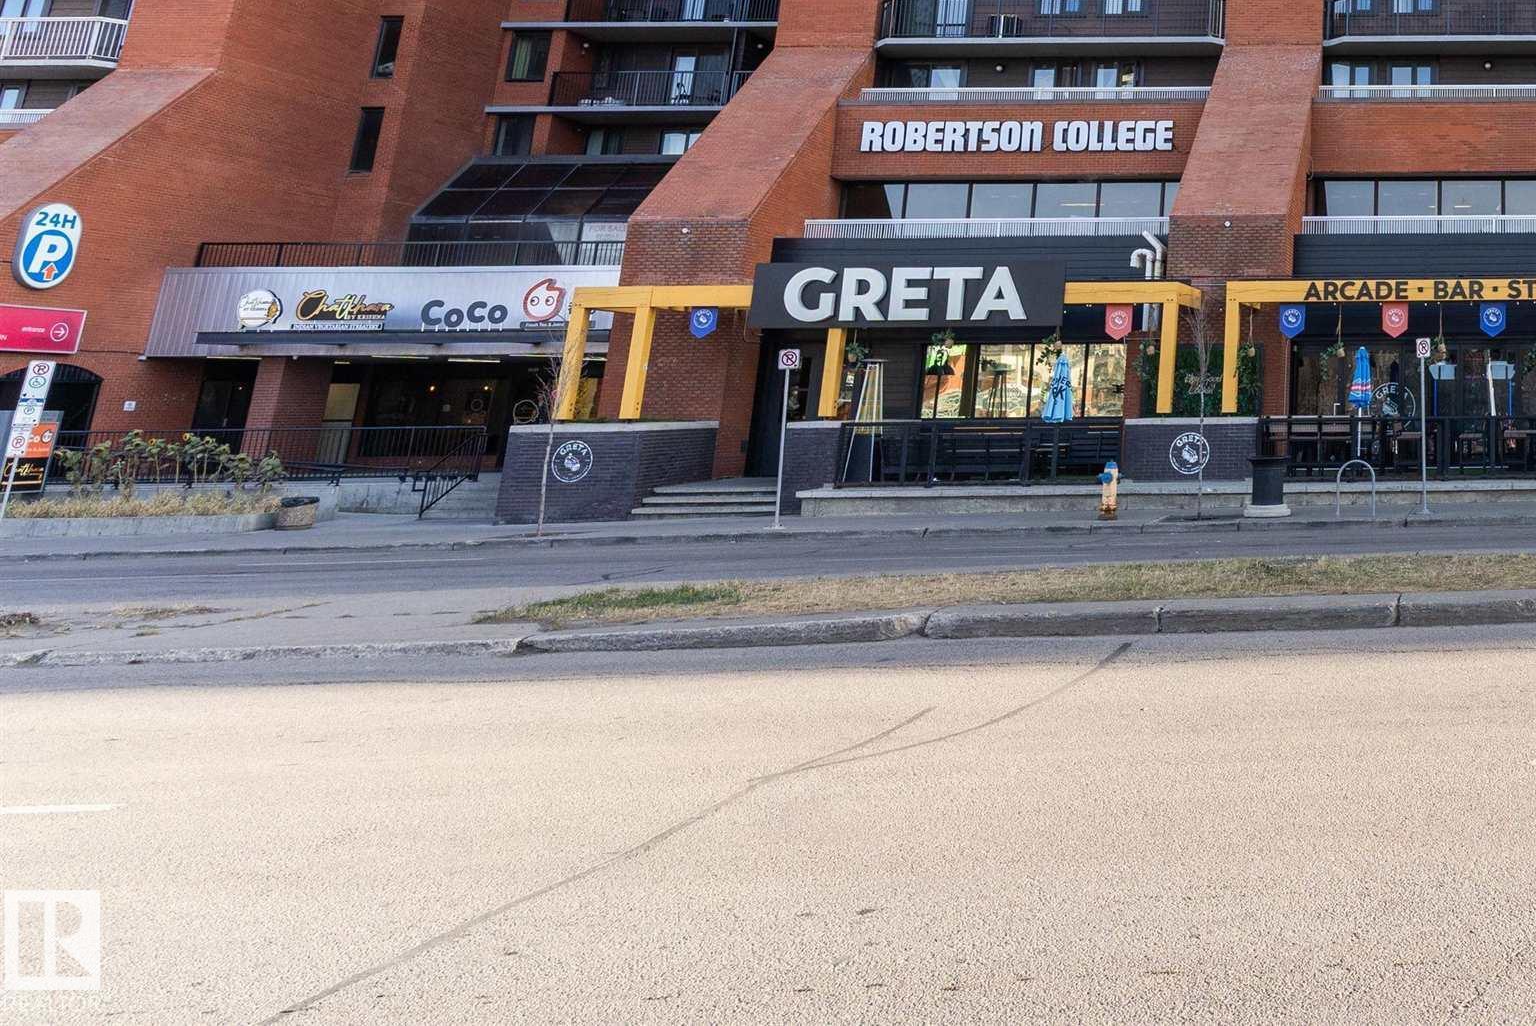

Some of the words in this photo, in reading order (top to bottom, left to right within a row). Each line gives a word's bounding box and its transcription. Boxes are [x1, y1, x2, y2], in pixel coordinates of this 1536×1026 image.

[860, 121, 1043, 152] ROBERTSON
[1052, 120, 1174, 151] COLLEGE
[36, 212, 77, 229] 24H
[28, 234, 69, 273] P
[783, 266, 1027, 323] GRETA
[1304, 280, 1409, 301] ARCADE
[1432, 280, 1484, 300] BAR
[421, 300, 508, 327] CoCo
[560, 443, 588, 456] GRETA
